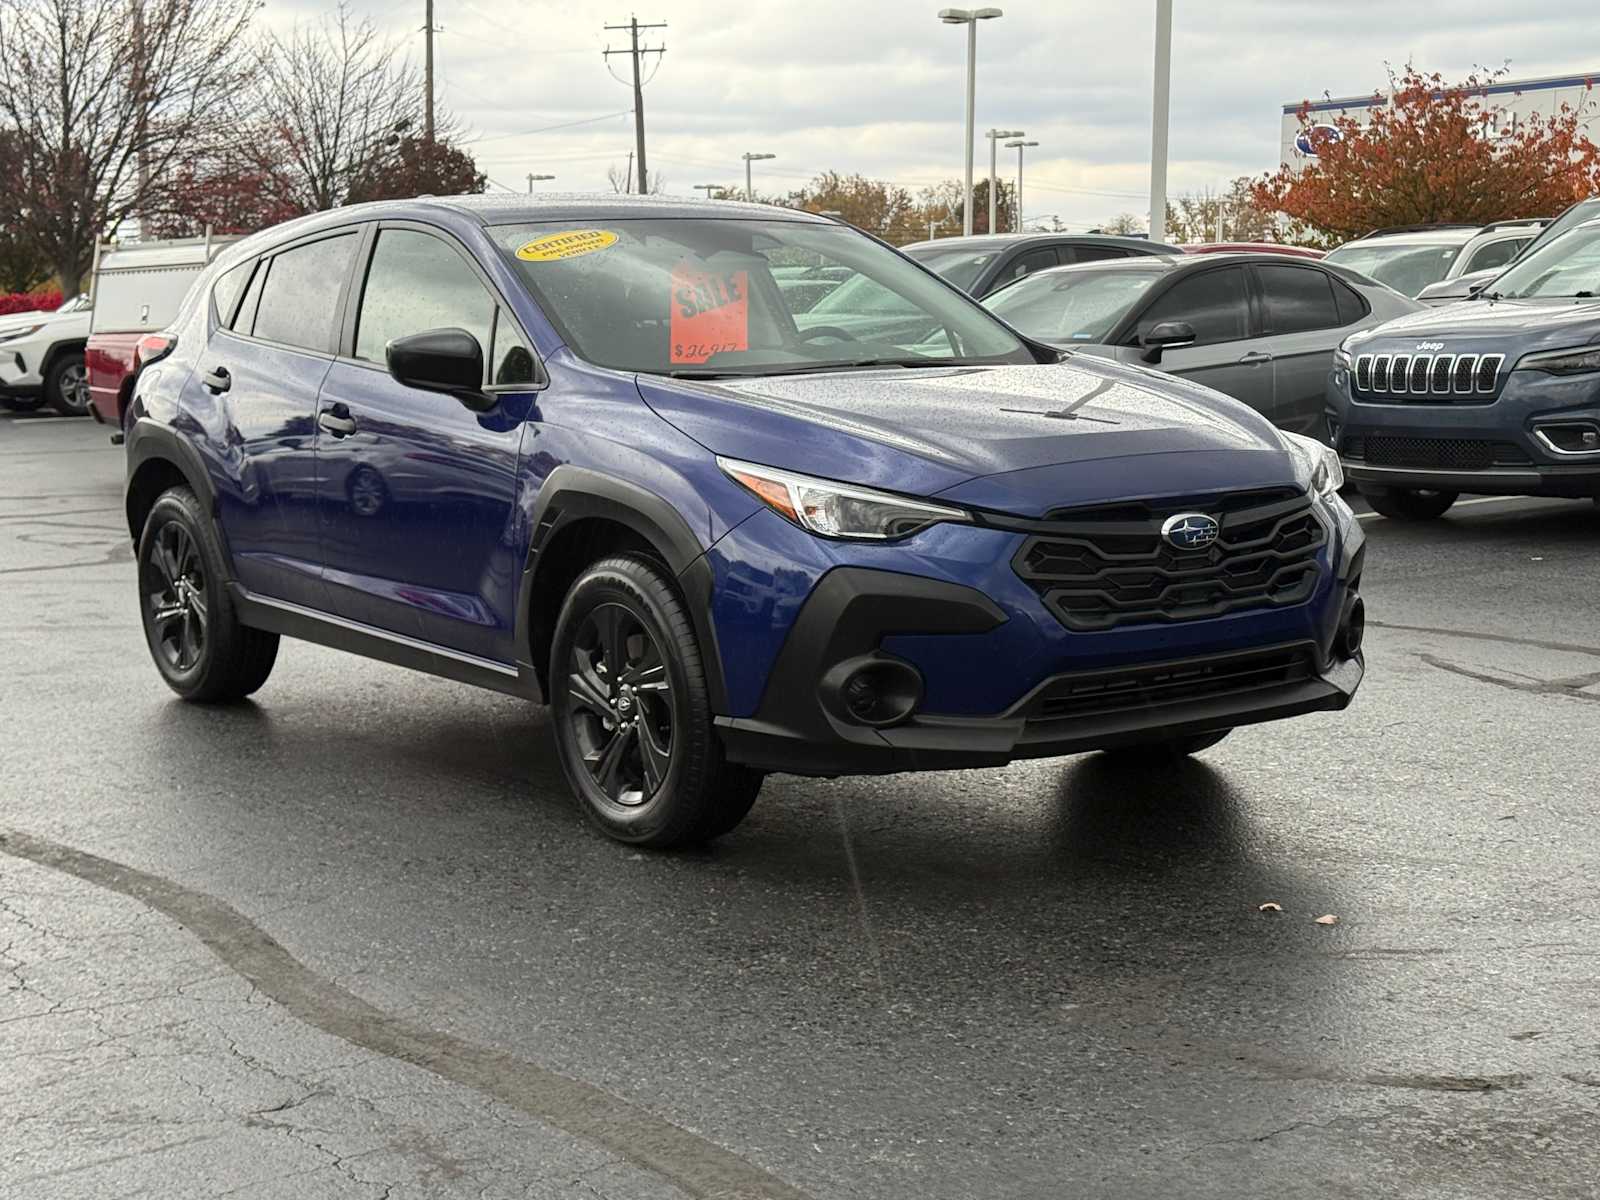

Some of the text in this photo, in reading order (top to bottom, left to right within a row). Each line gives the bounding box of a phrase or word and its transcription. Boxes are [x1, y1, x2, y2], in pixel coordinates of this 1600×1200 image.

[522, 231, 602, 254] CERTIFIED
[675, 273, 742, 319] SALE
[1416, 341, 1445, 351] Jeep
